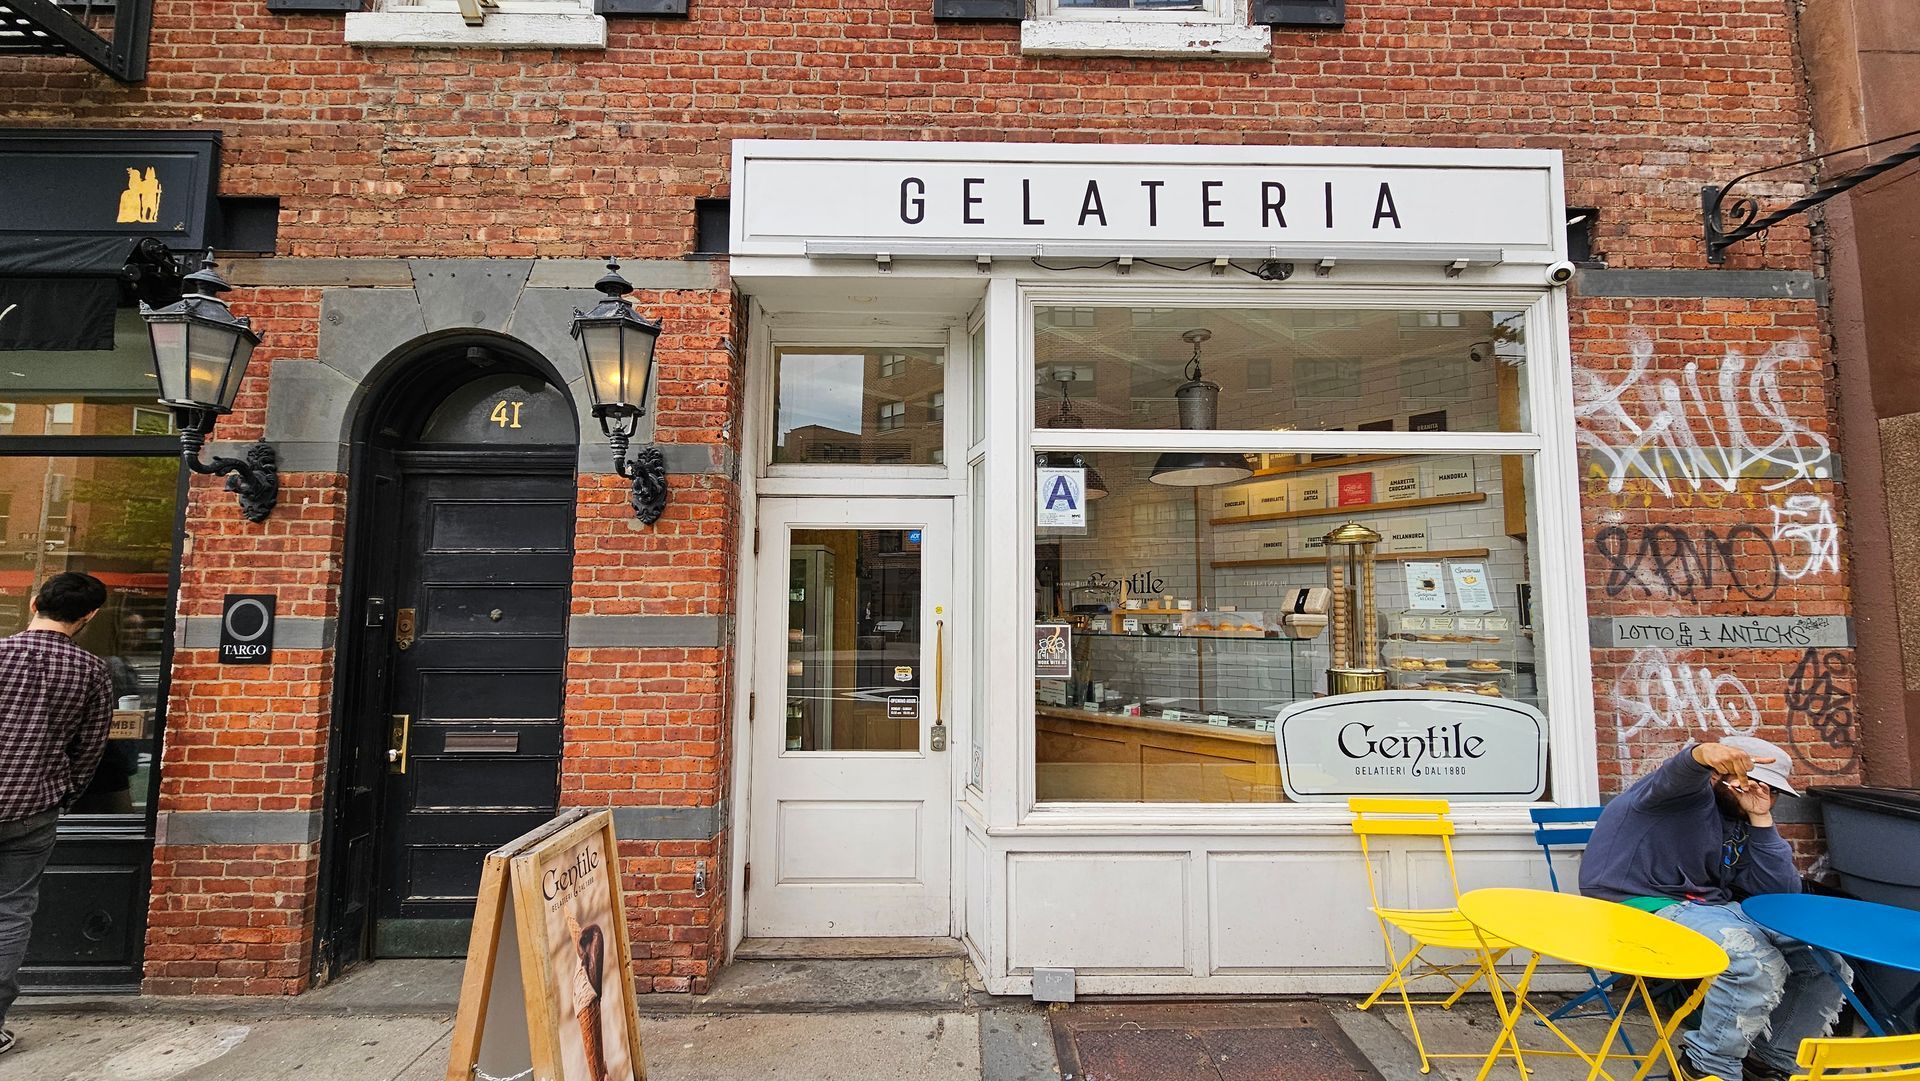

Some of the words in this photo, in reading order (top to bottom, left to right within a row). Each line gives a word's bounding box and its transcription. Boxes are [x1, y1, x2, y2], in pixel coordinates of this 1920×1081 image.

[900, 177, 1401, 229] GELATERIA
[490, 400, 523, 428] 41
[1390, 478, 1415, 486] AMARETTO
[1438, 472, 1468, 481] MANDORLA
[1045, 475, 1077, 510] A
[1388, 484, 1416, 492] CROCCANTE
[1087, 570, 1165, 595] Gentile
[1618, 624, 1674, 640] LOTTO
[222, 644, 267, 656] TARGO
[1338, 722, 1486, 777] Gentile
[1355, 766, 1406, 775] GELATIERI
[1425, 766, 1441, 775] DAL
[1444, 766, 1466, 775] 1880
[542, 845, 600, 901] Gentile
